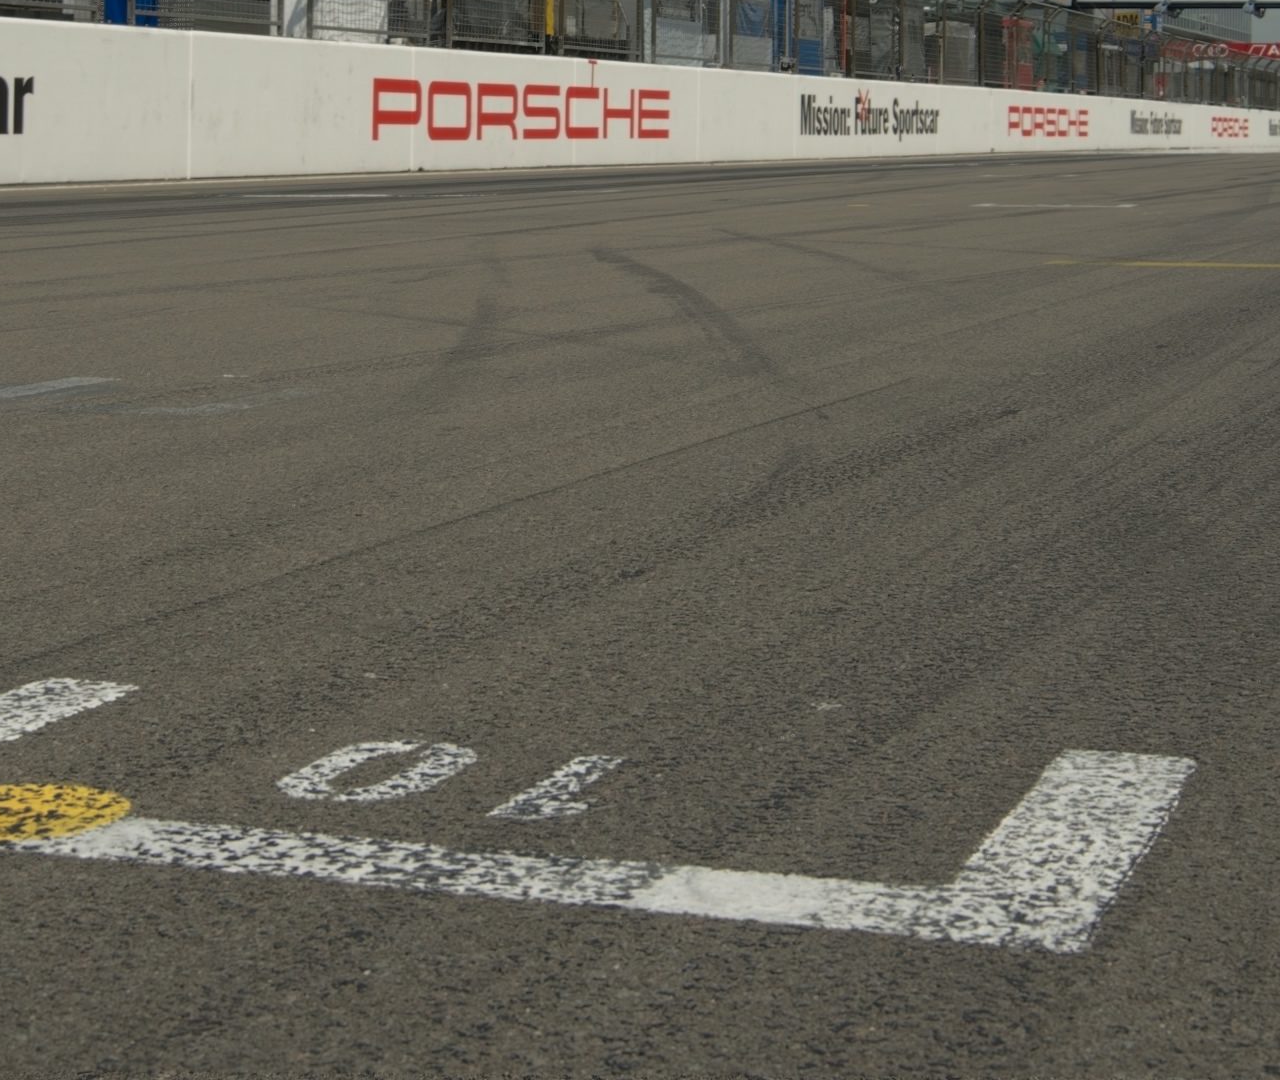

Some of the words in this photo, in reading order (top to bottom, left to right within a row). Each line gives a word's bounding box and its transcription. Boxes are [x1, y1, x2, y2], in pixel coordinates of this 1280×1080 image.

[372, 77, 671, 141] PORSCHE
[800, 94, 850, 136] Mission:
[855, 97, 889, 135] Future
[892, 99, 940, 142] Sportscar
[1008, 104, 1089, 137] PORSCHE
[1211, 116, 1249, 138] PORSCHE
[275, 741, 628, 820] 10
